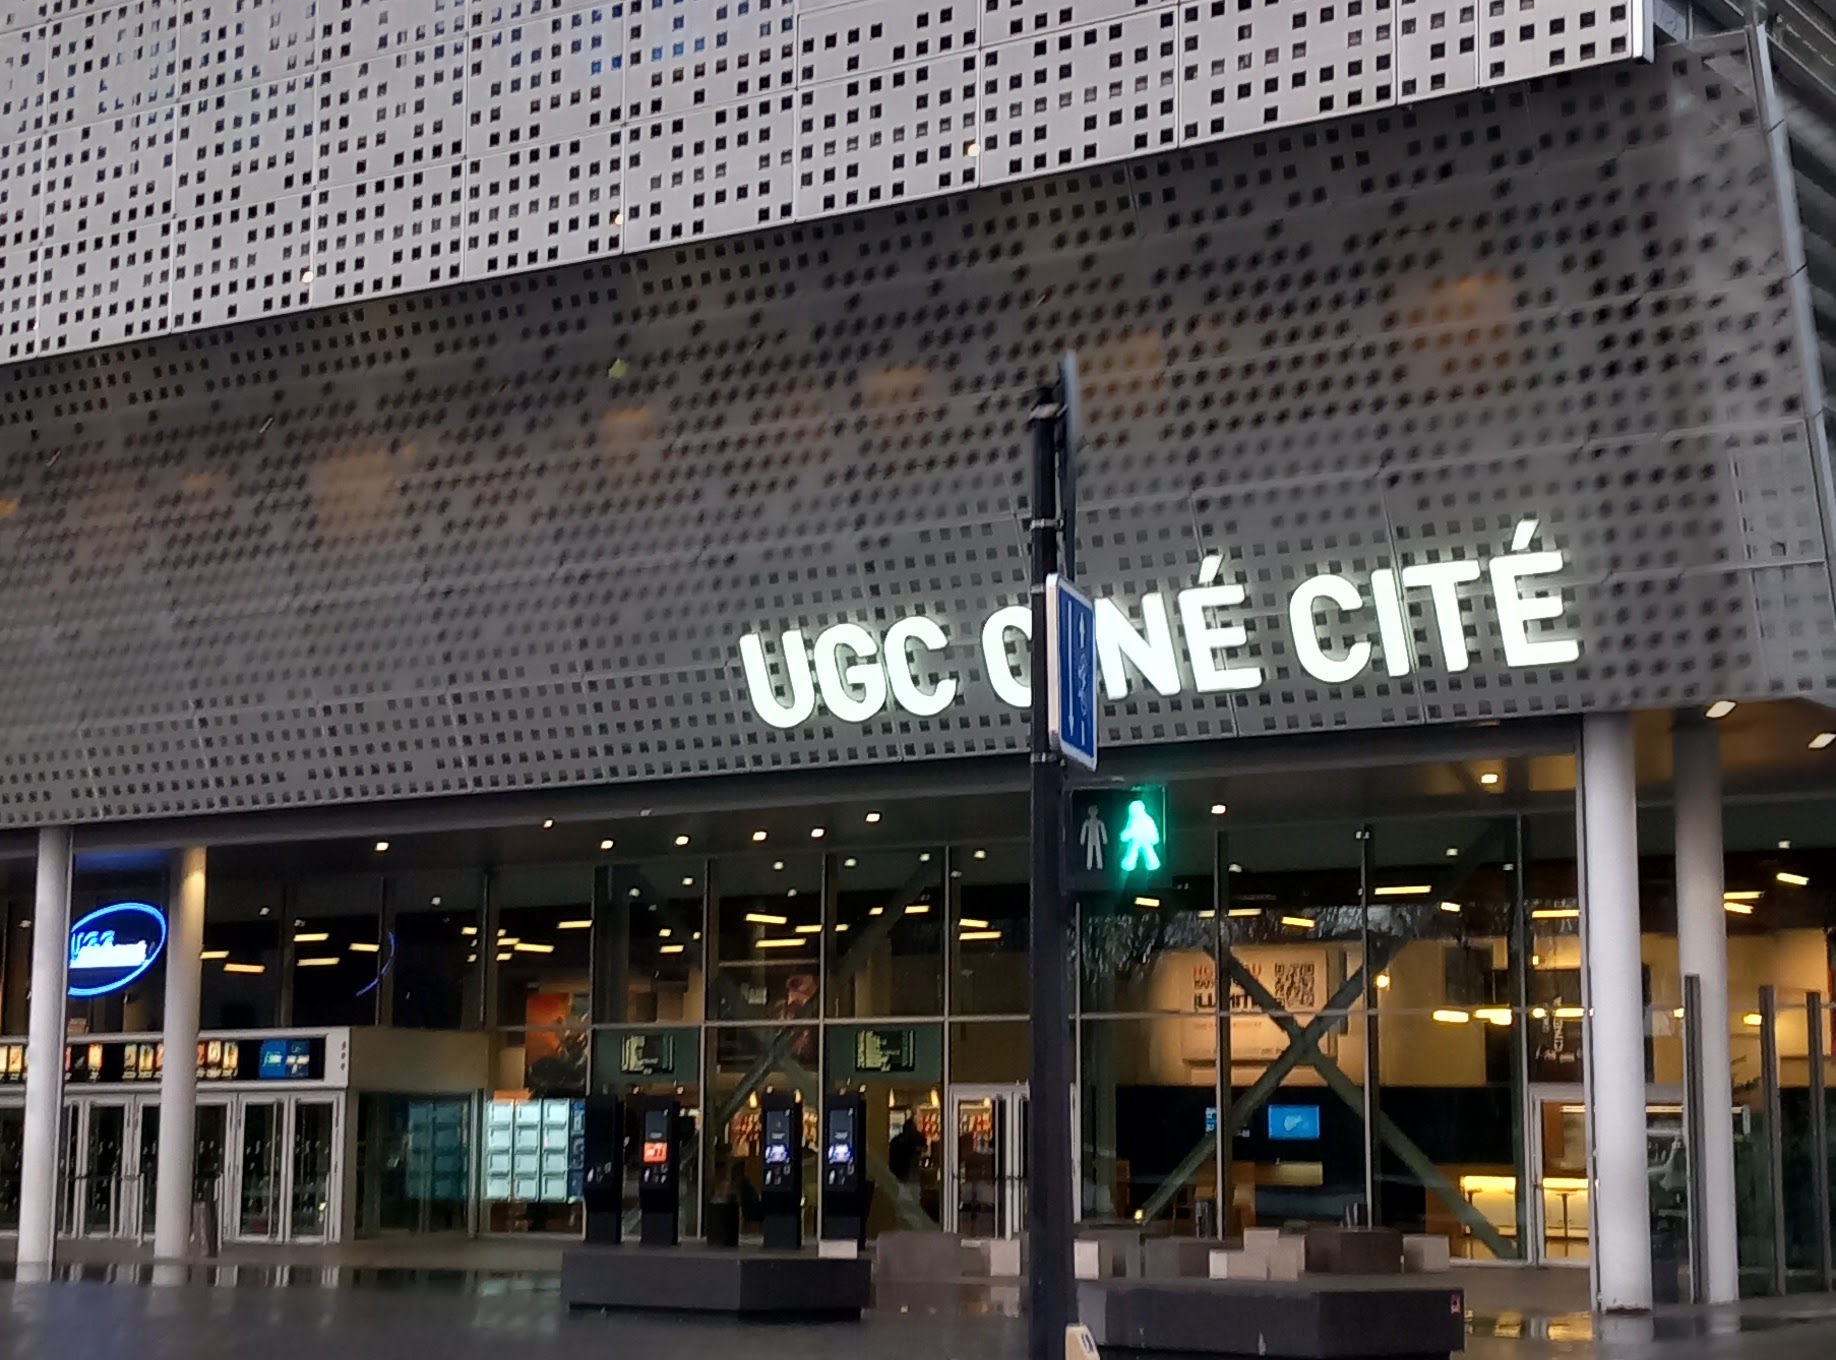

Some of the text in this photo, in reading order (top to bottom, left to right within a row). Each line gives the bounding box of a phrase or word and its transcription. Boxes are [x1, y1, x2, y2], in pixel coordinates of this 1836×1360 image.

[739, 518, 1580, 728] UGC CNÉ CITÉ
